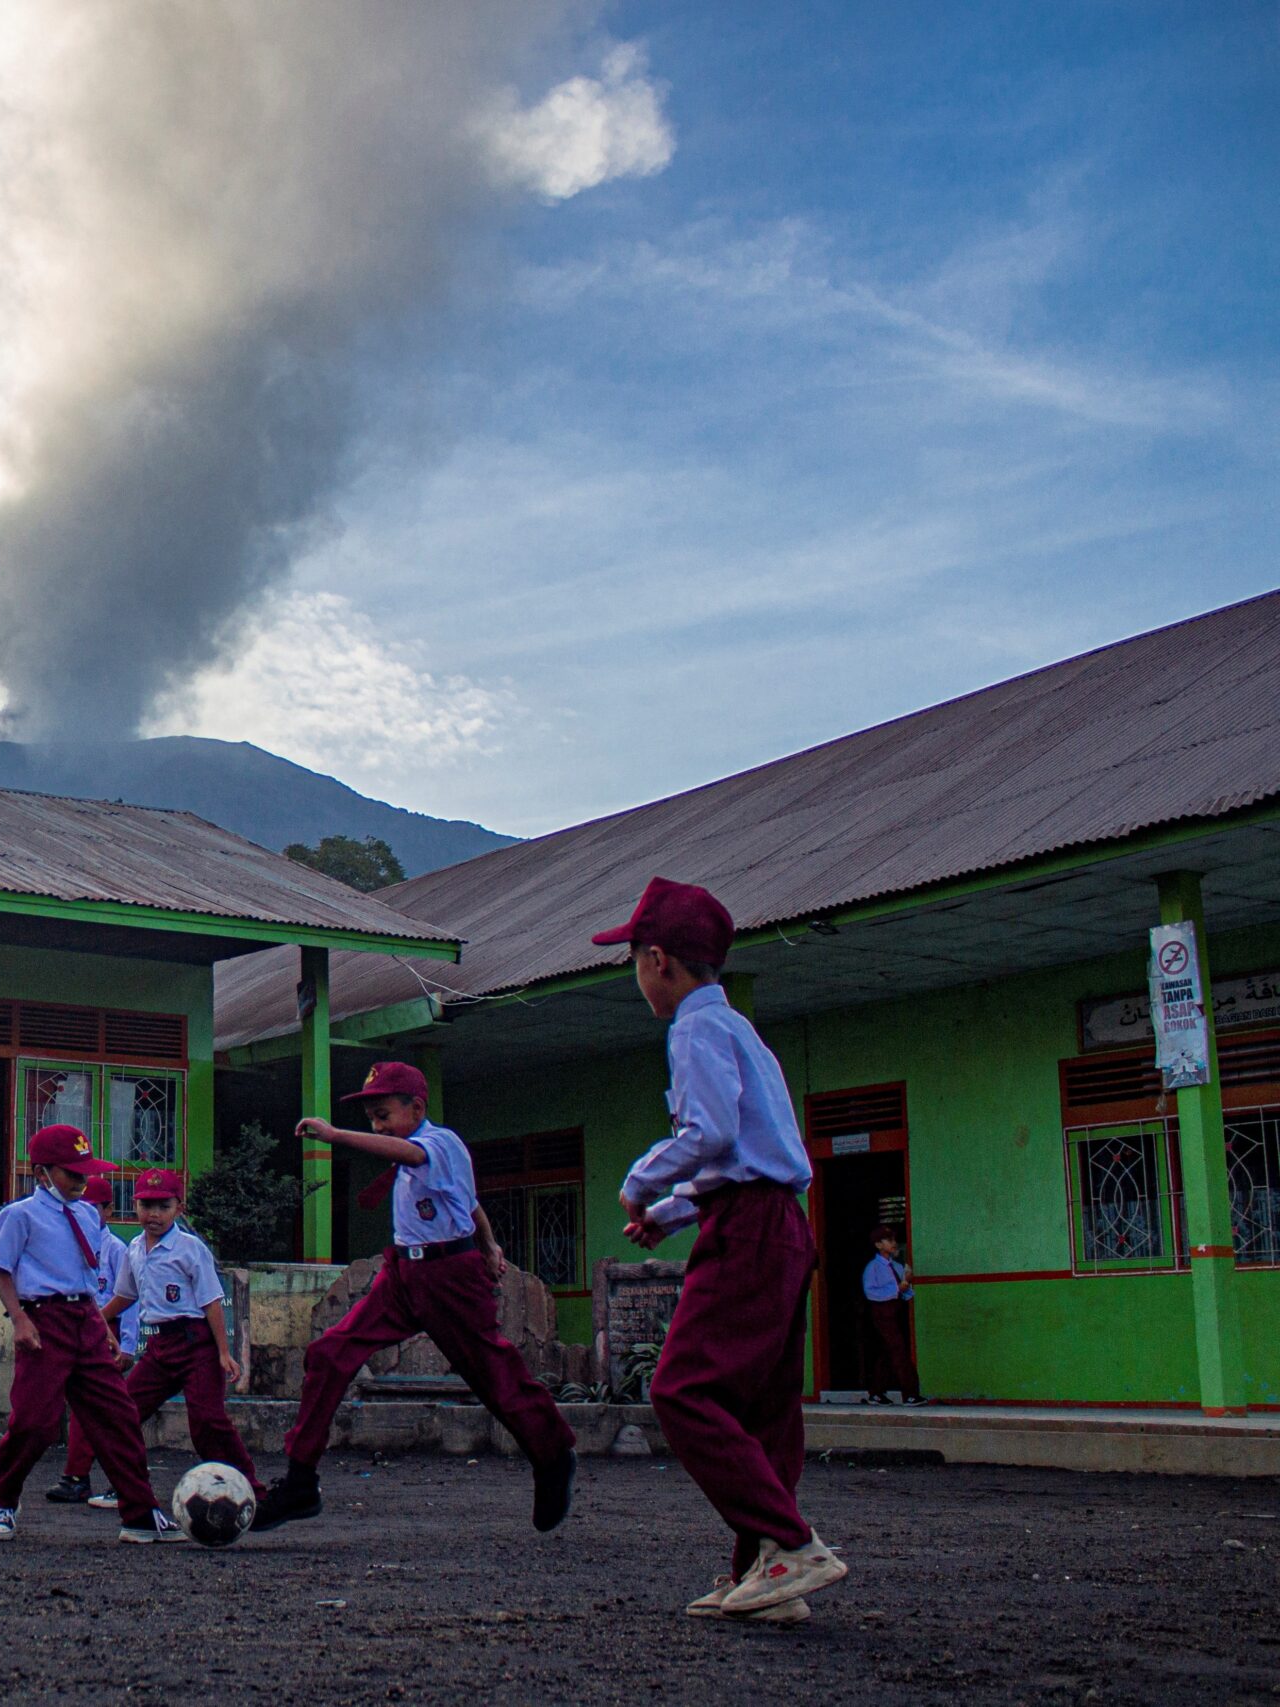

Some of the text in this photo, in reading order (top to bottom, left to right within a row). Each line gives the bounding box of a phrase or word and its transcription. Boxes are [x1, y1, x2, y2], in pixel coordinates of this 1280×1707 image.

[1162, 988, 1194, 1002] TANPA
[1163, 1001, 1195, 1021] ASAP
[1164, 1019, 1197, 1034] ROKOK
